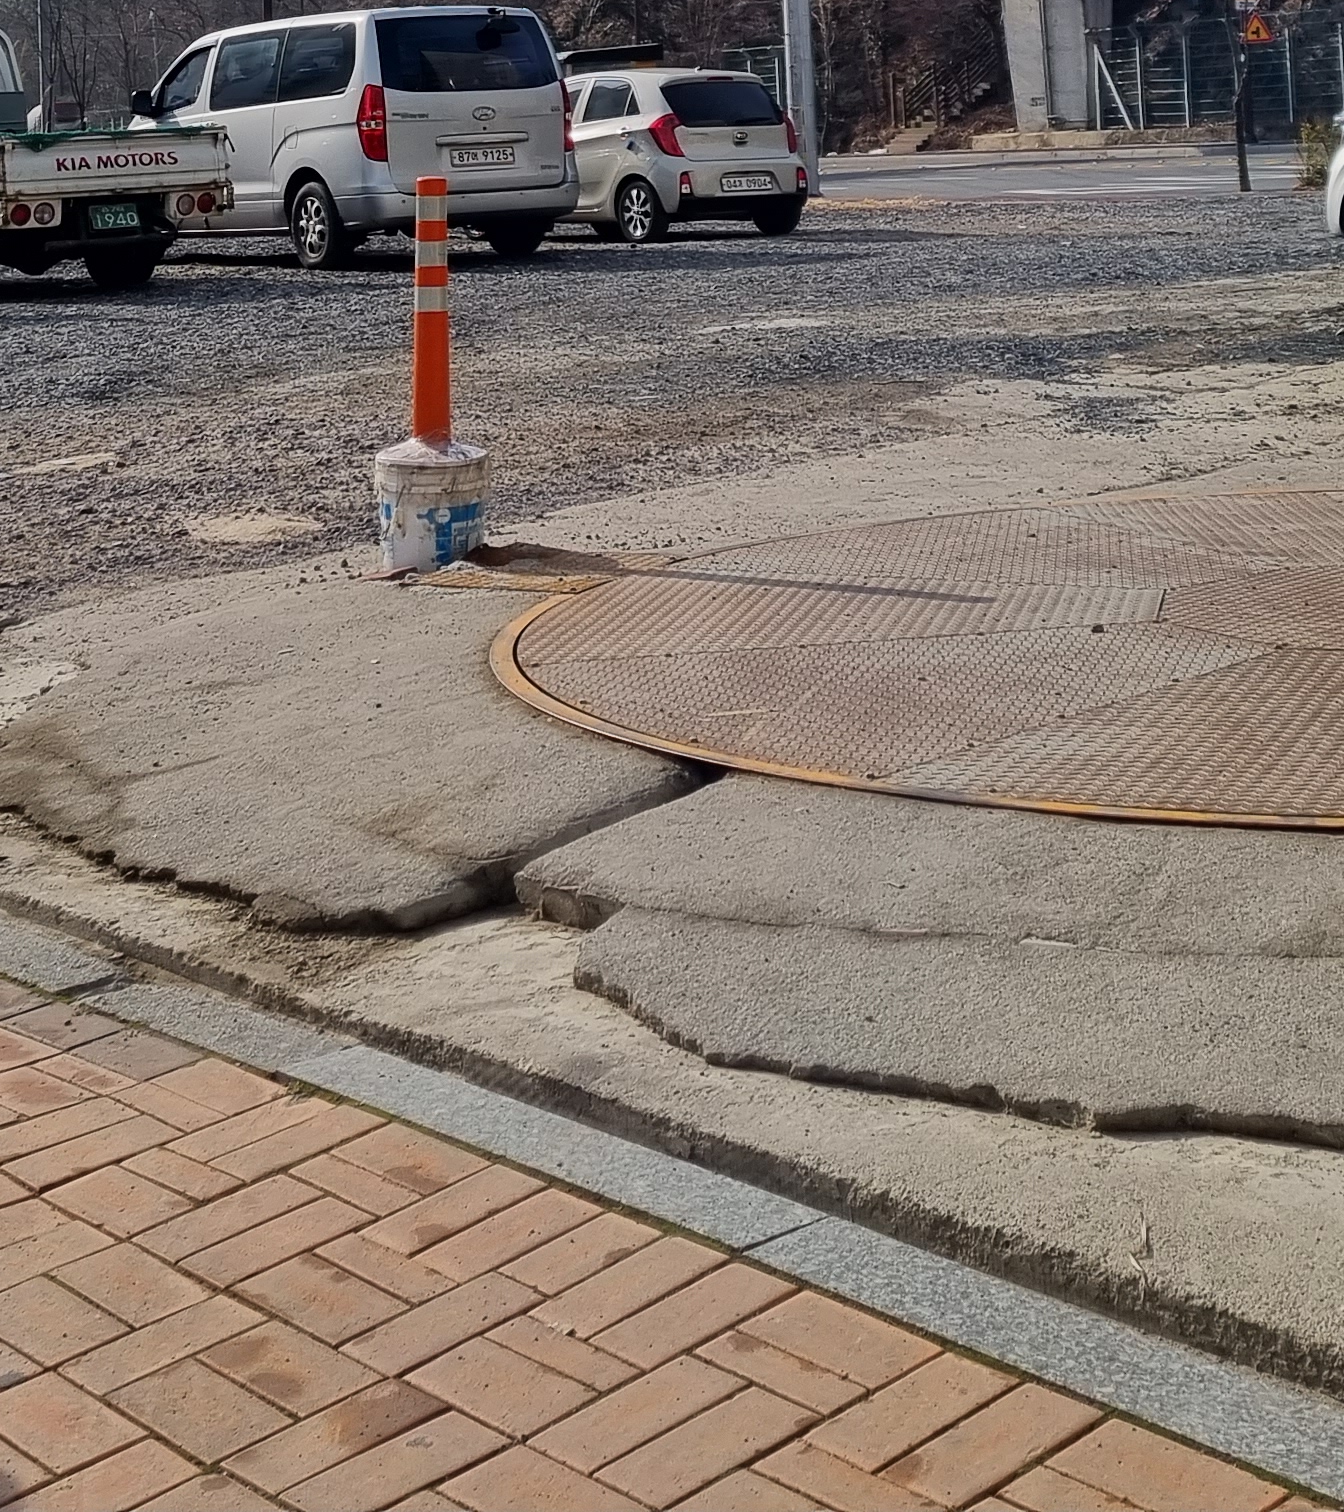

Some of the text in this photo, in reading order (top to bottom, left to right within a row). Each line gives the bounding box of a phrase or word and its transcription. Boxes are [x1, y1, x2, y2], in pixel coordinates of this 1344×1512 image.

[56, 151, 179, 172] KIA MOTORS
[482, 149, 509, 161] 9125
[96, 212, 138, 228] 1940
